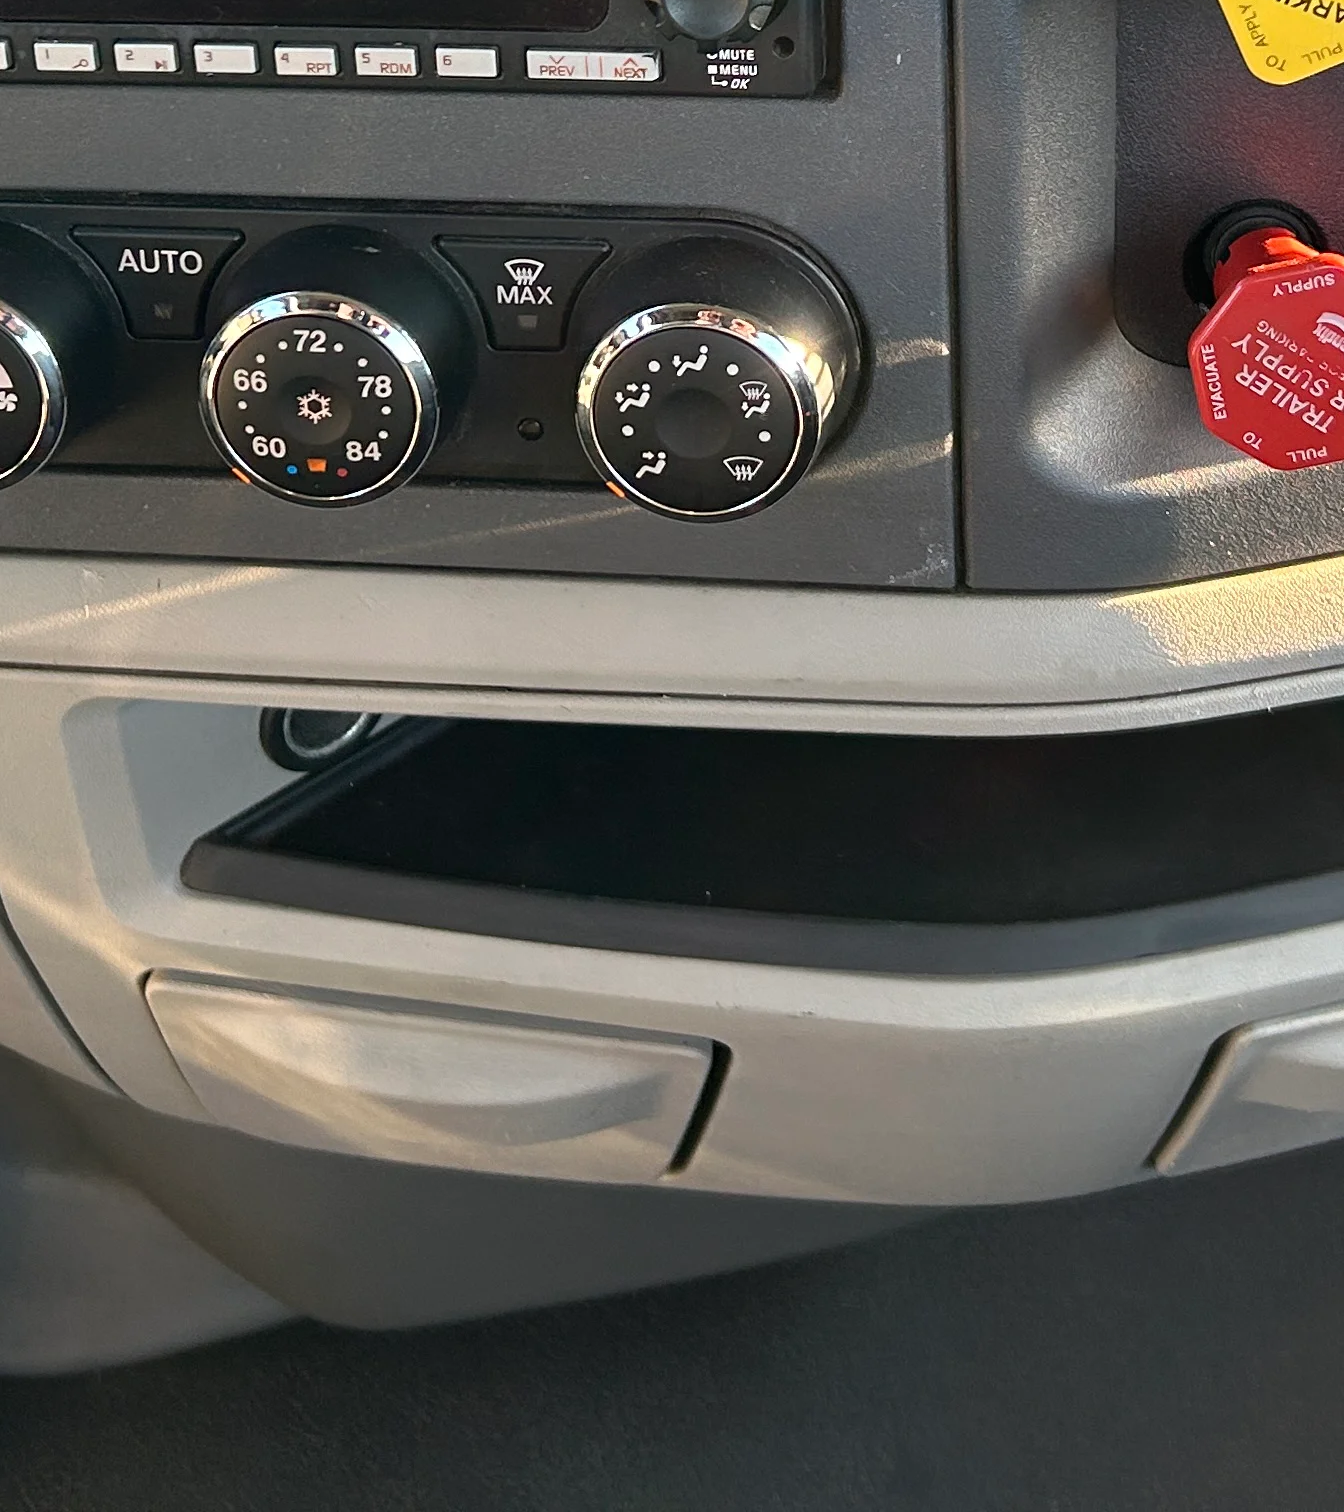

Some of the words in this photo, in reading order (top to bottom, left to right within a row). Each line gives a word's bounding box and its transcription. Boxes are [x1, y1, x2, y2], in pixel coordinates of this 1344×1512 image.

[1238, 3, 1269, 48] APPLY
[125, 49, 134, 61] 2
[204, 51, 213, 62] 3
[280, 53, 289, 63] 4
[362, 53, 371, 64] 5
[443, 55, 452, 66] 6
[719, 49, 755, 61] MUTE
[1265, 55, 1287, 72] TO
[1302, 42, 1343, 65] PULL
[307, 62, 332, 74] RPT
[380, 63, 413, 74] RDM
[539, 65, 575, 77] PREV
[614, 67, 649, 79] NEXT
[719, 64, 758, 76] MENU
[730, 78, 749, 89] OK
[118, 249, 204, 275] AUTO
[496, 285, 553, 306] MAX
[1272, 272, 1336, 298] SUPPLY
[293, 329, 327, 353] 72
[1256, 319, 1314, 364] ARKING
[1231, 332, 1331, 398] SUPPLY
[233, 368, 268, 393] 66
[357, 375, 393, 399] 78
[1200, 343, 1228, 421] EVACUATE
[1234, 363, 1337, 434] TRAILER
[252, 435, 287, 459] 60
[345, 440, 382, 462] 84
[1242, 430, 1264, 451] TO
[1286, 445, 1328, 463] PULL
